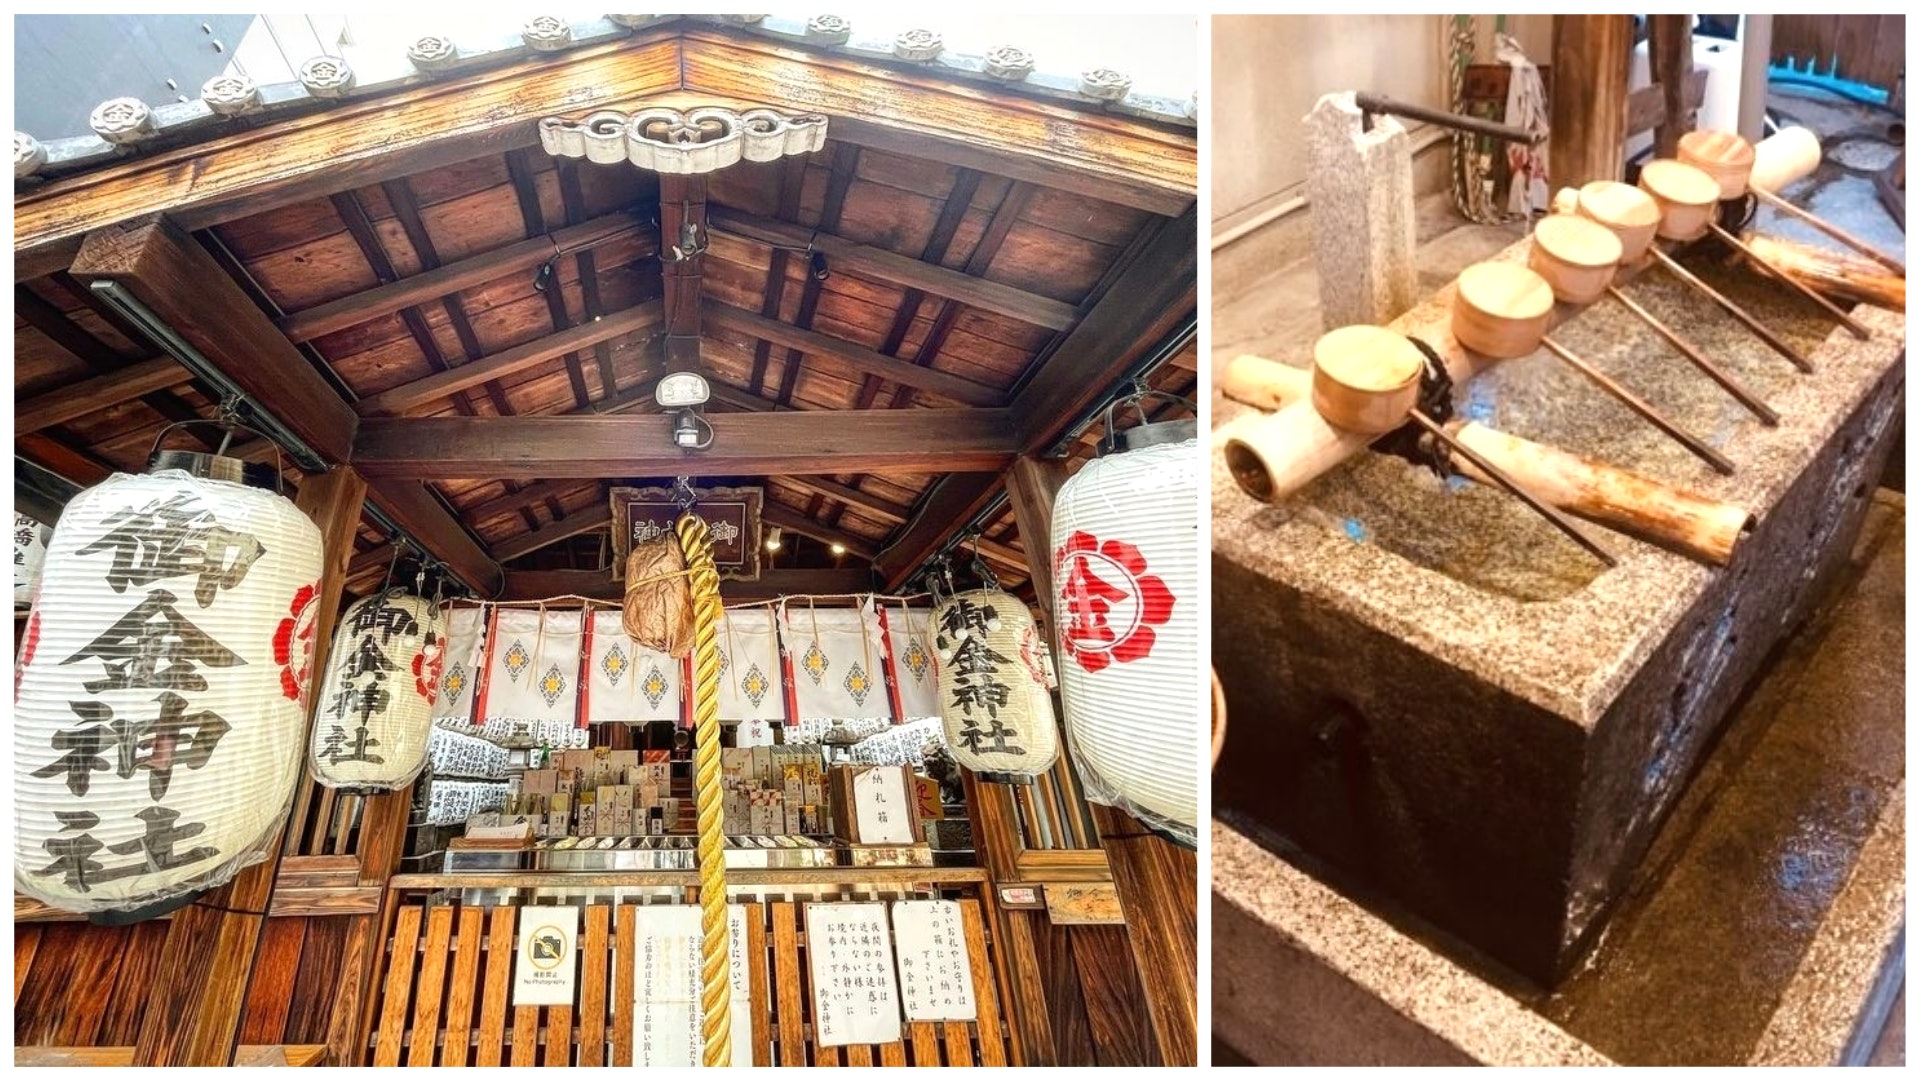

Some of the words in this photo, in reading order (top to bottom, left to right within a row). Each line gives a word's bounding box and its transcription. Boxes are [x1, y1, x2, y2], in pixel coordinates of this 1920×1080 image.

[1061, 556, 1130, 643] 金
[30, 490, 267, 892] 御金神社
[318, 599, 415, 766] 御金神社
[940, 599, 1026, 756] 御金神社
[872, 776, 888, 823] 納札箱
[731, 919, 742, 991] お参りについて
[827, 923, 842, 1001] お参り下さい
[849, 923, 864, 988] ならない様
[903, 957, 918, 1010] 御金神社
[922, 950, 937, 1006] 下さいませ
[819, 987, 832, 1035] 御金神社
